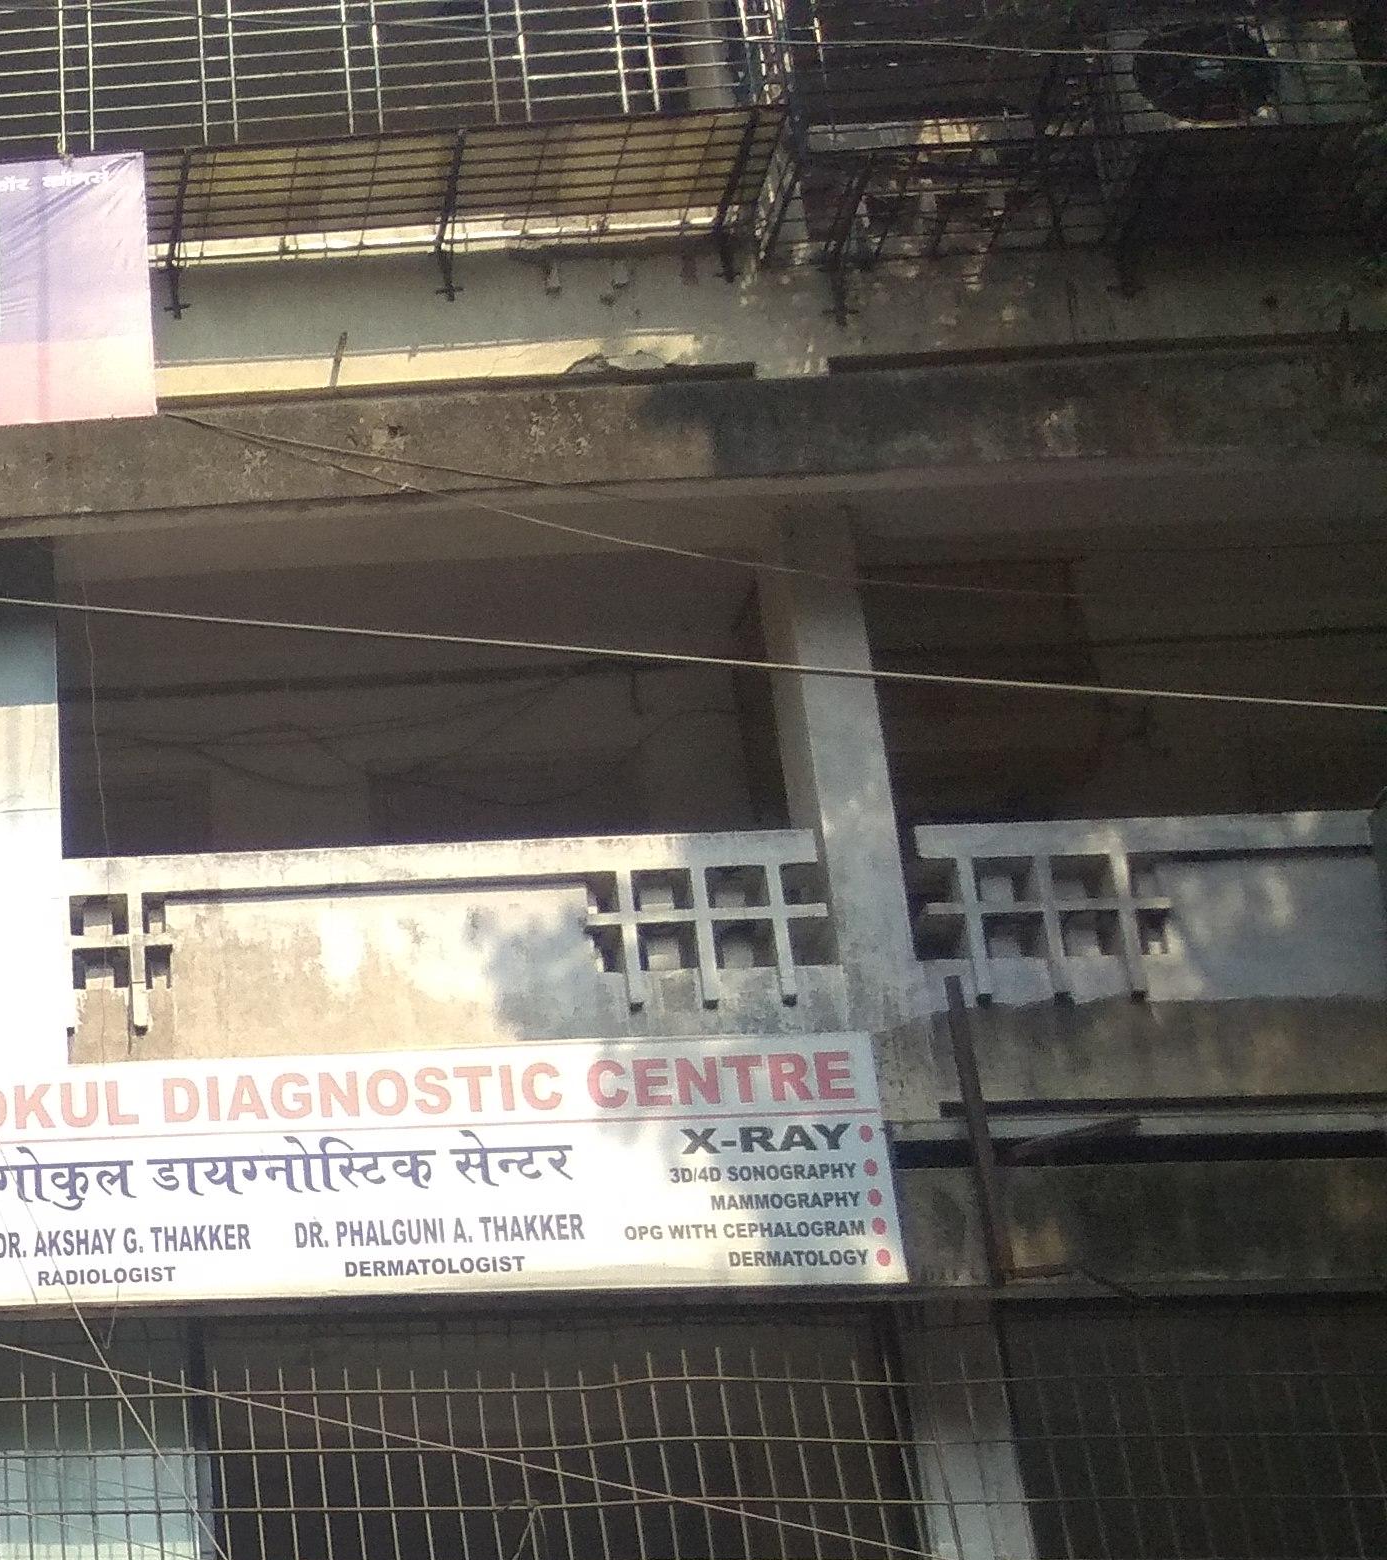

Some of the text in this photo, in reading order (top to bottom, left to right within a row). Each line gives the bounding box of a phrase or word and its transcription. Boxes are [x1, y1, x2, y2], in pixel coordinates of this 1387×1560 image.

[162, 1065, 562, 1123] DIAGNOSTIC
[587, 1051, 856, 1109] CENTRE
[680, 1123, 850, 1154] X-RAY
[147, 1136, 436, 1194] डायग्नोस्टिक
[449, 1130, 573, 1186] सेन्टर
[669, 1162, 855, 1183] 3D/4D SONOGRAPHY
[711, 1192, 860, 1210] MAMMOGRAPHY
[33, 1229, 116, 1256] AKSHAY
[150, 1224, 251, 1252] THAKKER
[295, 1214, 585, 1248] DR. PHALGUNI THAKKER
[624, 1220, 865, 1240] OPG WITH CEPHALOGRAM
[345, 1256, 524, 1277] DERMATOLOGIST
[729, 1249, 868, 1267] DERMATOLOGY
[37, 1267, 176, 1286] RADIOLOGIST
